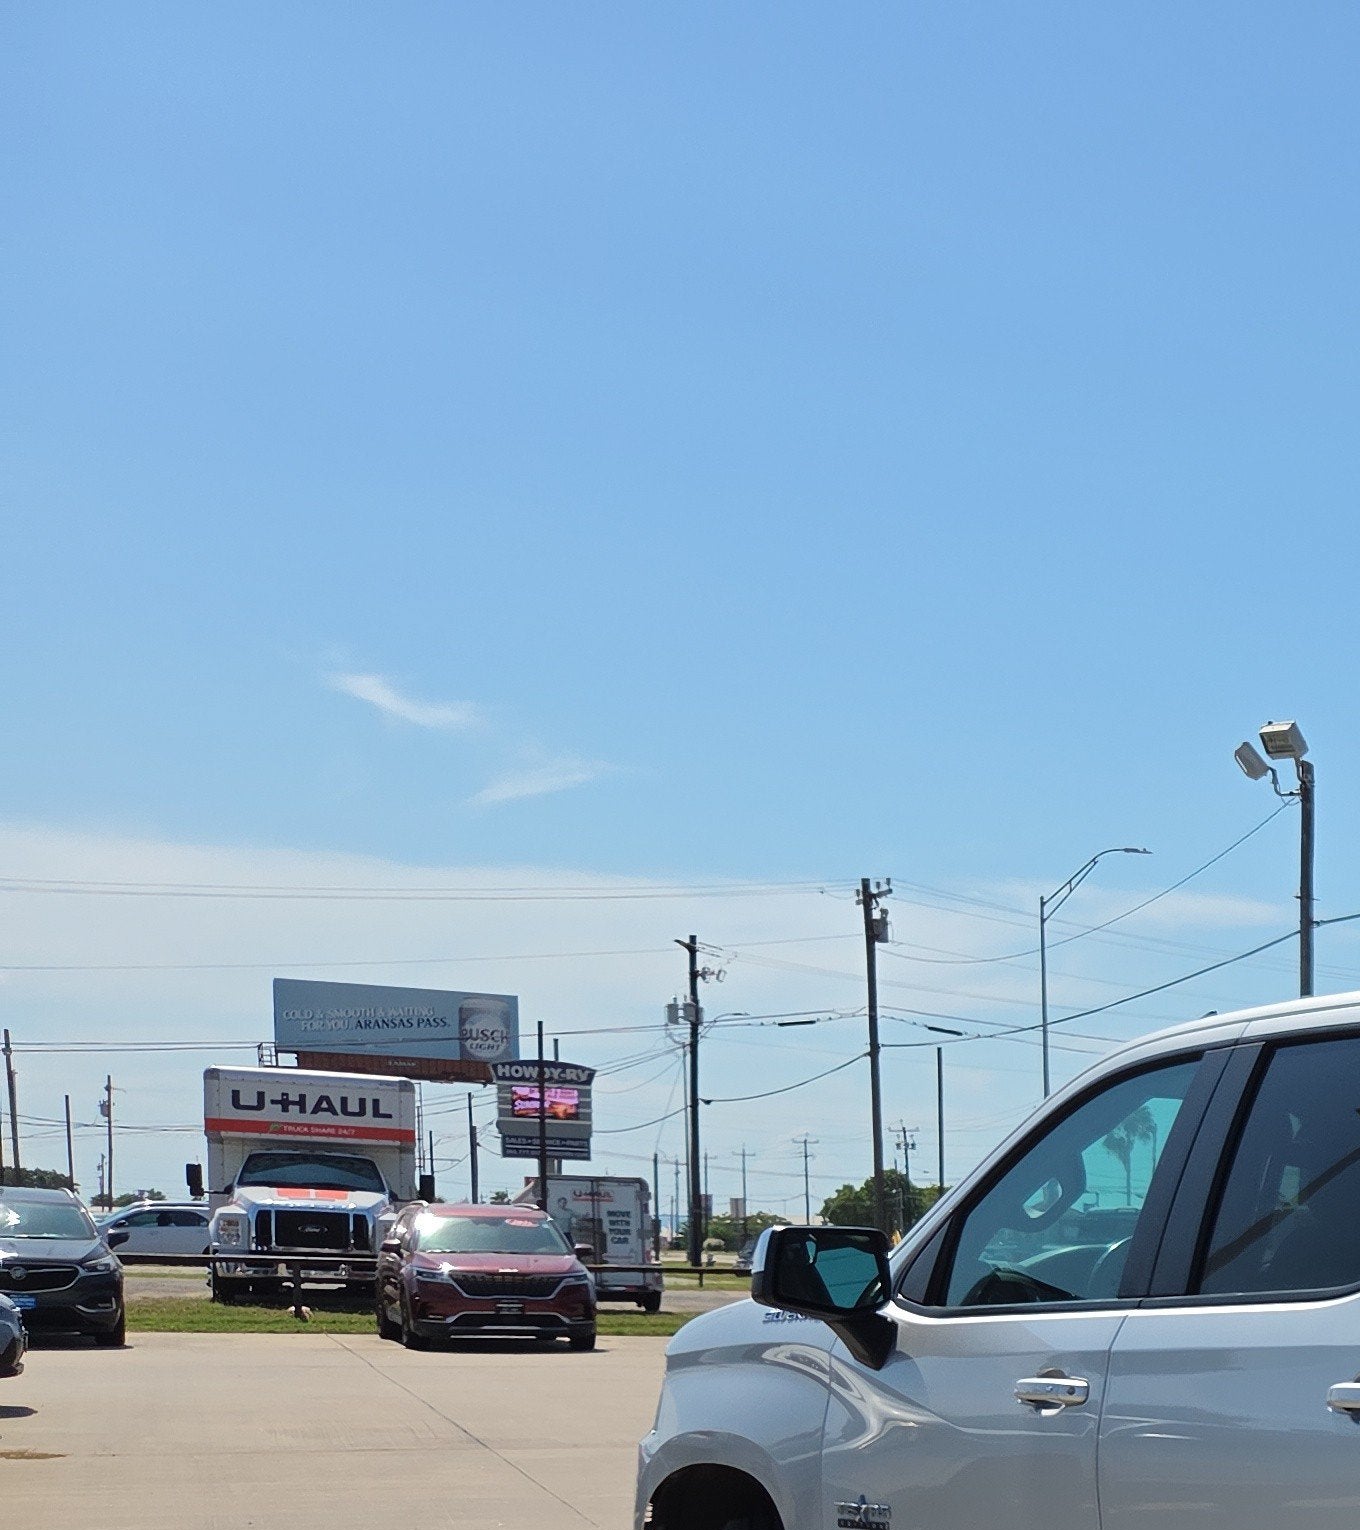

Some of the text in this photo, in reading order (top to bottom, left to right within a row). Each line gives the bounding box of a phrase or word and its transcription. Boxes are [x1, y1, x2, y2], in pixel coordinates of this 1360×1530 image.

[283, 1009, 313, 1021] COLD
[302, 1019, 327, 1032] FOR
[354, 1017, 414, 1031] ARANSAS
[461, 1028, 508, 1044] BUSCH
[469, 1042, 500, 1051] LIGHT
[231, 1089, 393, 1119] U-HAUL
[610, 1236, 629, 1245] CAR
